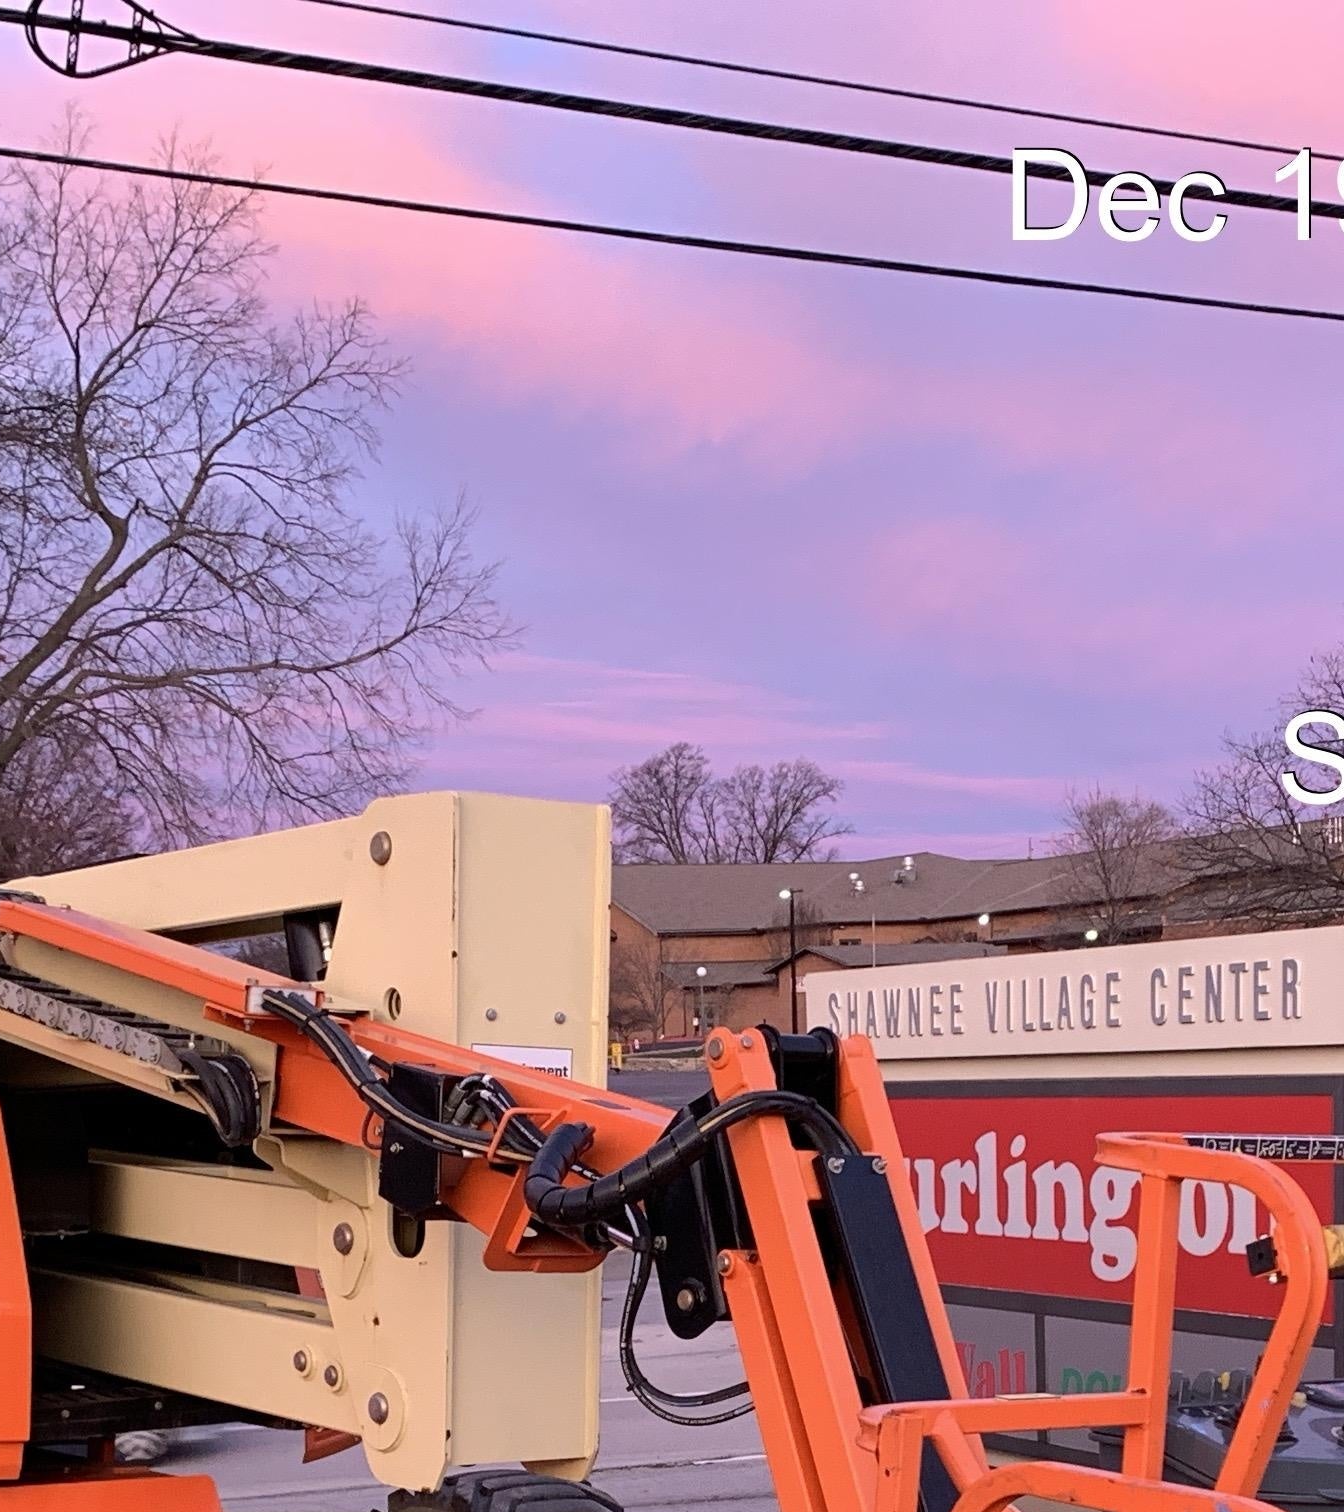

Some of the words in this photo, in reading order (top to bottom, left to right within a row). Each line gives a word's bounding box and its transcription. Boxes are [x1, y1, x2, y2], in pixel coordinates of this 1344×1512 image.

[828, 983, 964, 1038] SHAWNEE
[985, 971, 1123, 1034] VILLAGE
[1149, 958, 1304, 1027] CENTER
[904, 1130, 1278, 1282] urlingo
